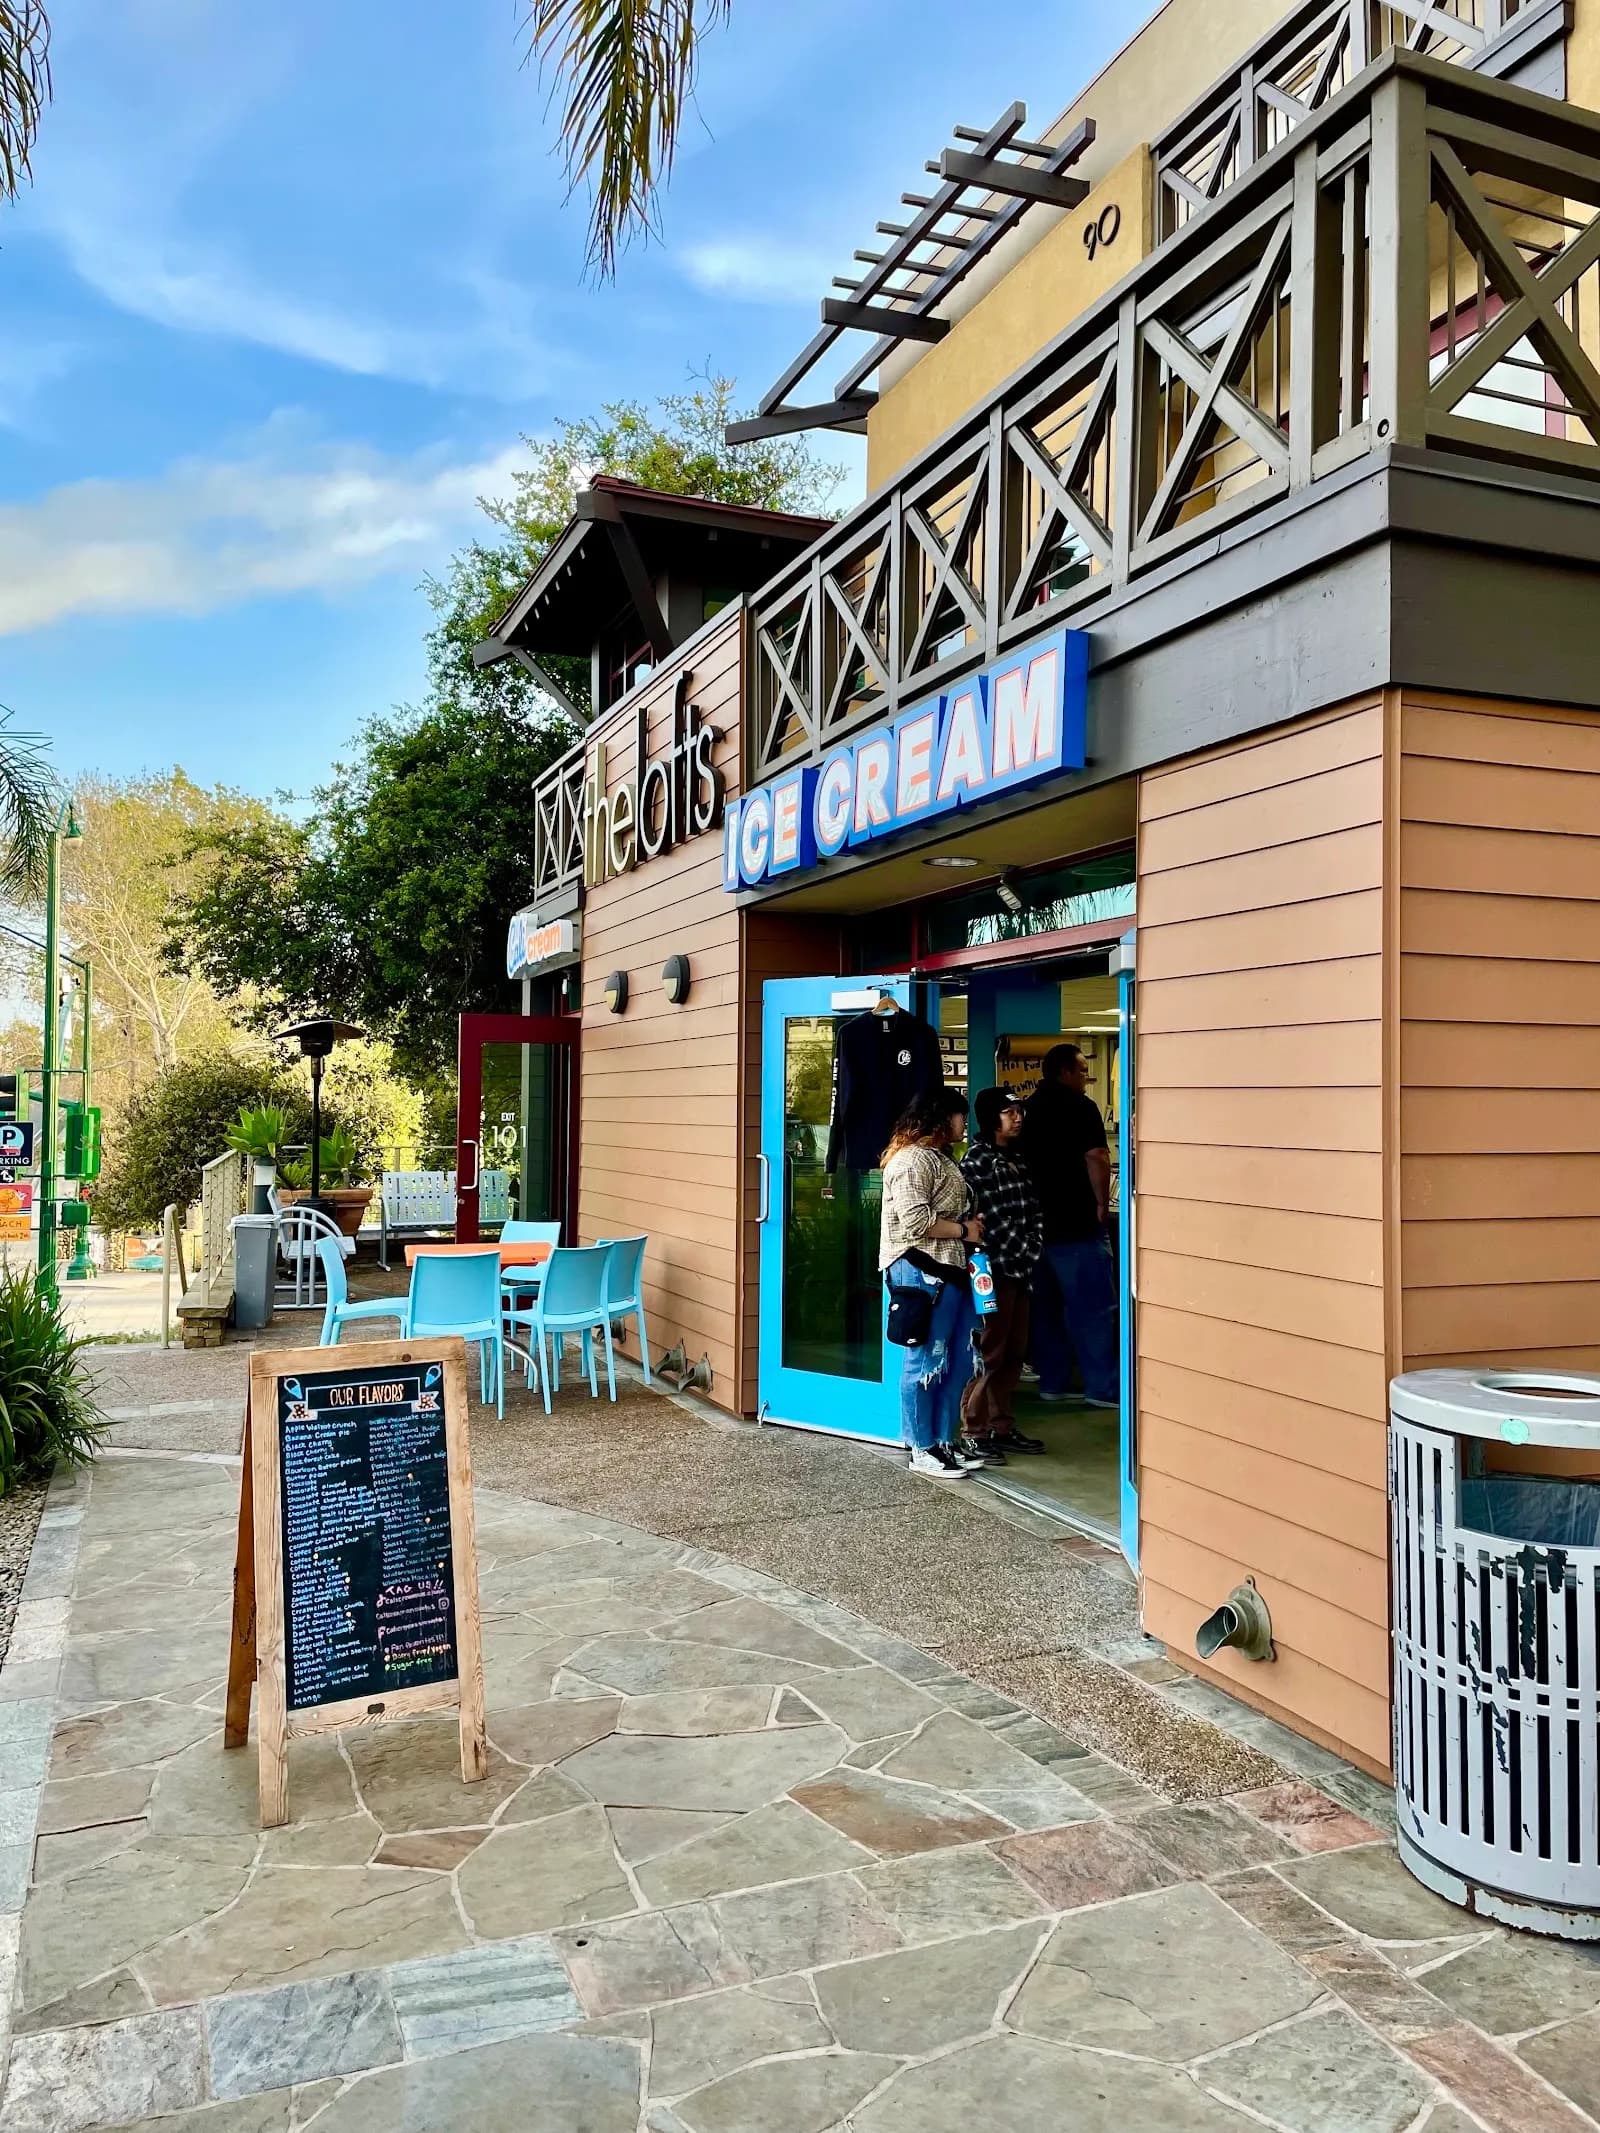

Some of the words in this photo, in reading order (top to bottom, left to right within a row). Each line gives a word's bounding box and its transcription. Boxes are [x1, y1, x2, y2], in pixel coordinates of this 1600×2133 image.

[1083, 204, 1120, 261] 90
[727, 781, 799, 881] ICE
[817, 648, 1058, 846] CREAM
[528, 923, 561, 961] cream
[501, 1112, 515, 1121] EXIT
[3, 1130, 16, 1144] P
[491, 1125, 527, 1148] 101
[329, 1388, 354, 1406] OUR
[358, 1383, 404, 1405] FLAVORS
[285, 1425, 305, 1434] Apple
[385, 1584, 412, 1596] TAG
[294, 1693, 322, 1705] Mango
